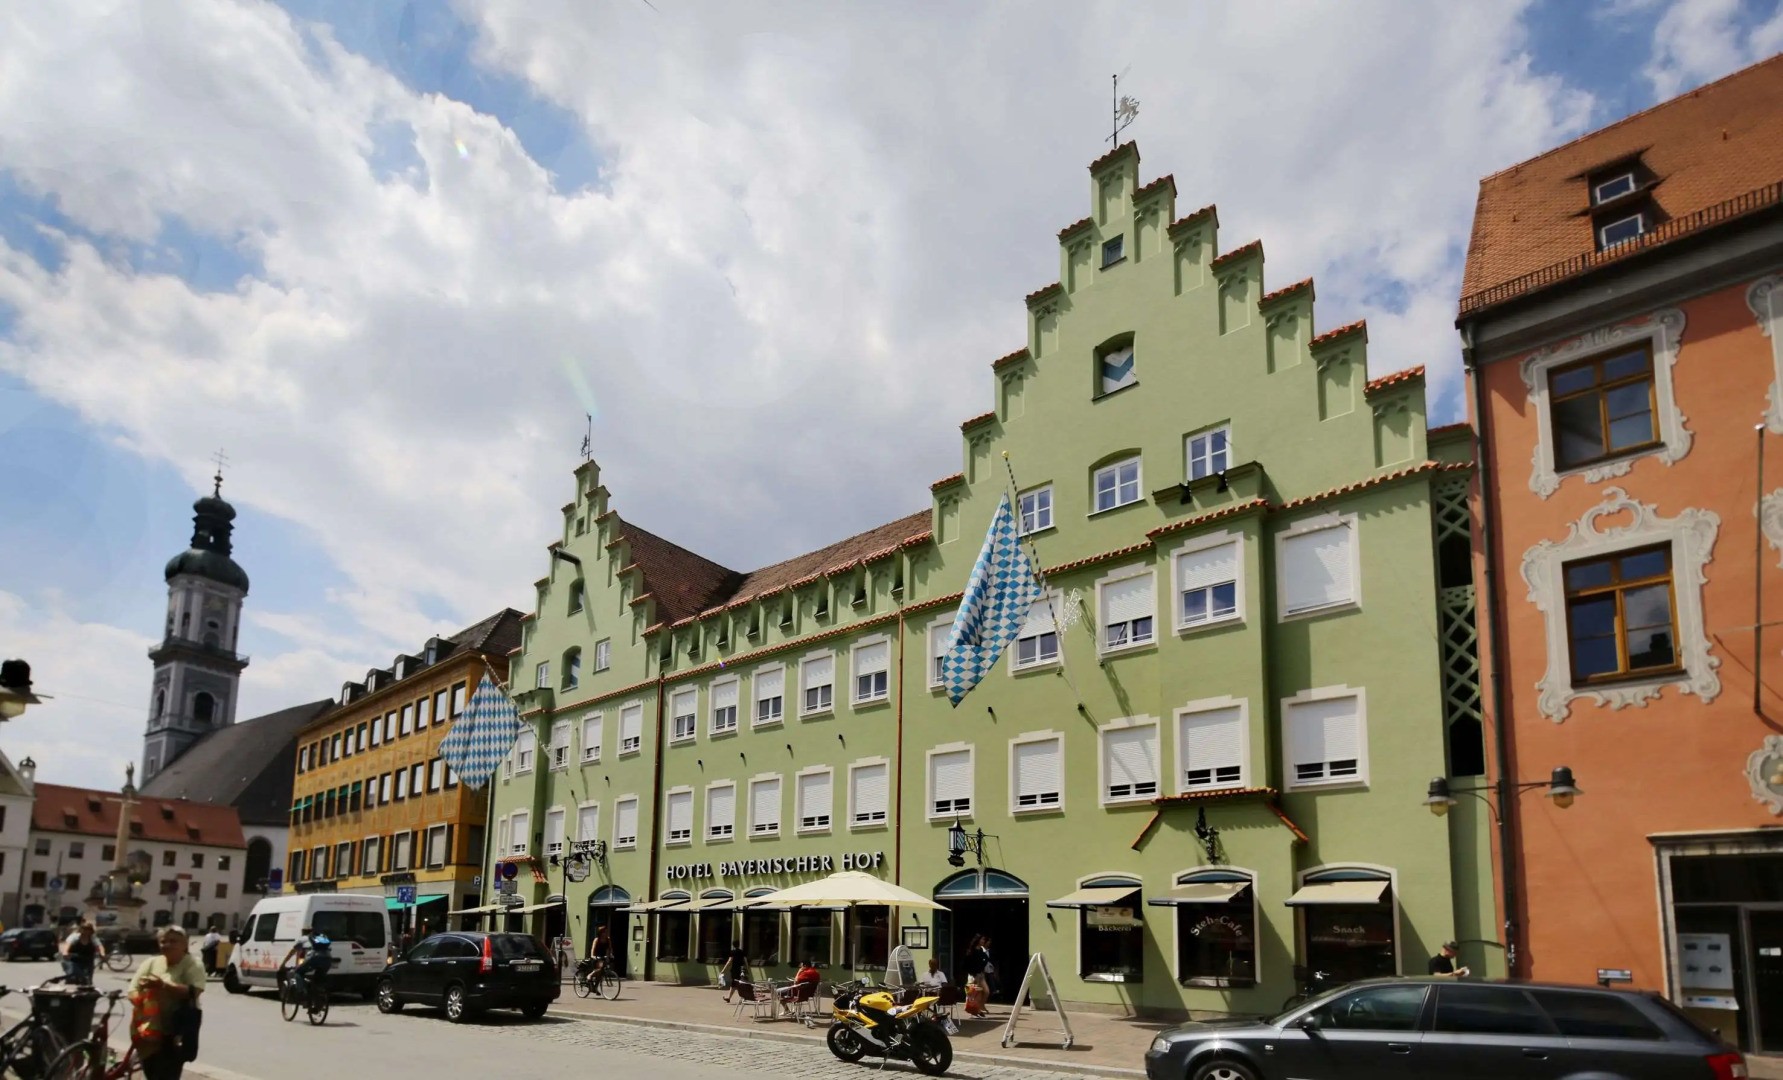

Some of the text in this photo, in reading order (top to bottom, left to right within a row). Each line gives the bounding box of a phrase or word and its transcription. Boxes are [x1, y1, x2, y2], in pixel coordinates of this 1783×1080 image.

[666, 851, 883, 880] HOTEL BAYERISCHER HOF
[1333, 925, 1365, 933] Snack
